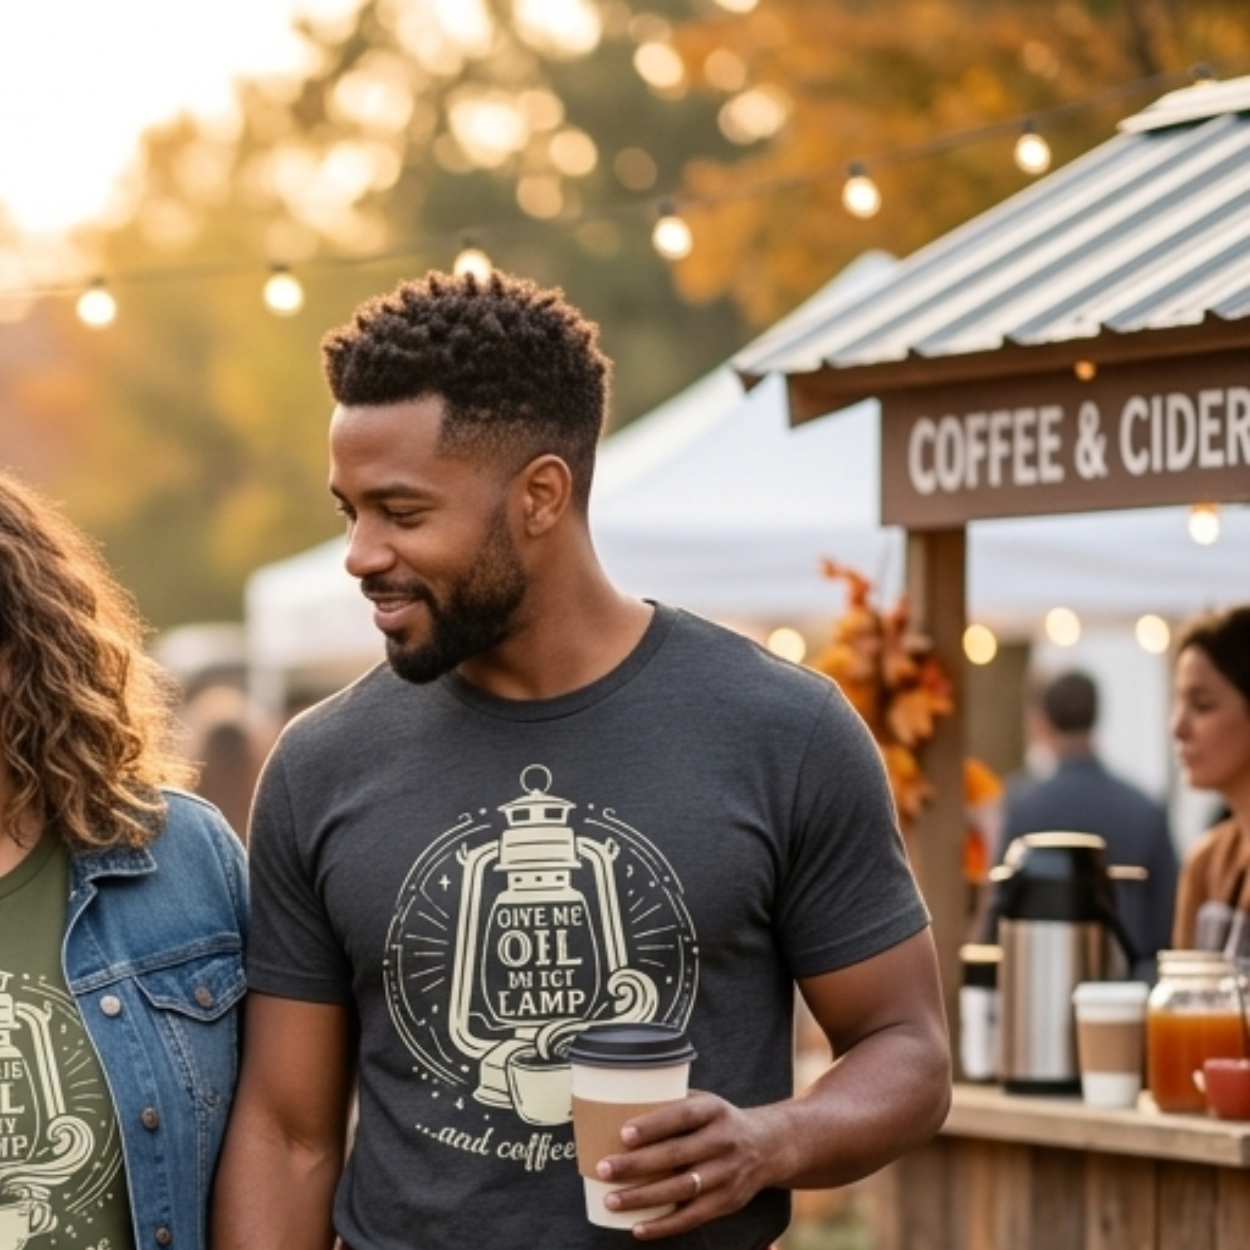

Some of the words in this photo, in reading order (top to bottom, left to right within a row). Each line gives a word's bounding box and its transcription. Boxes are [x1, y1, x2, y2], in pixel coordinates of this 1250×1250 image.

[908, 405, 1064, 494] COFFEE
[1074, 401, 1108, 479] &
[1119, 387, 1250, 476] CIDER
[497, 990, 586, 1016] LAMP
